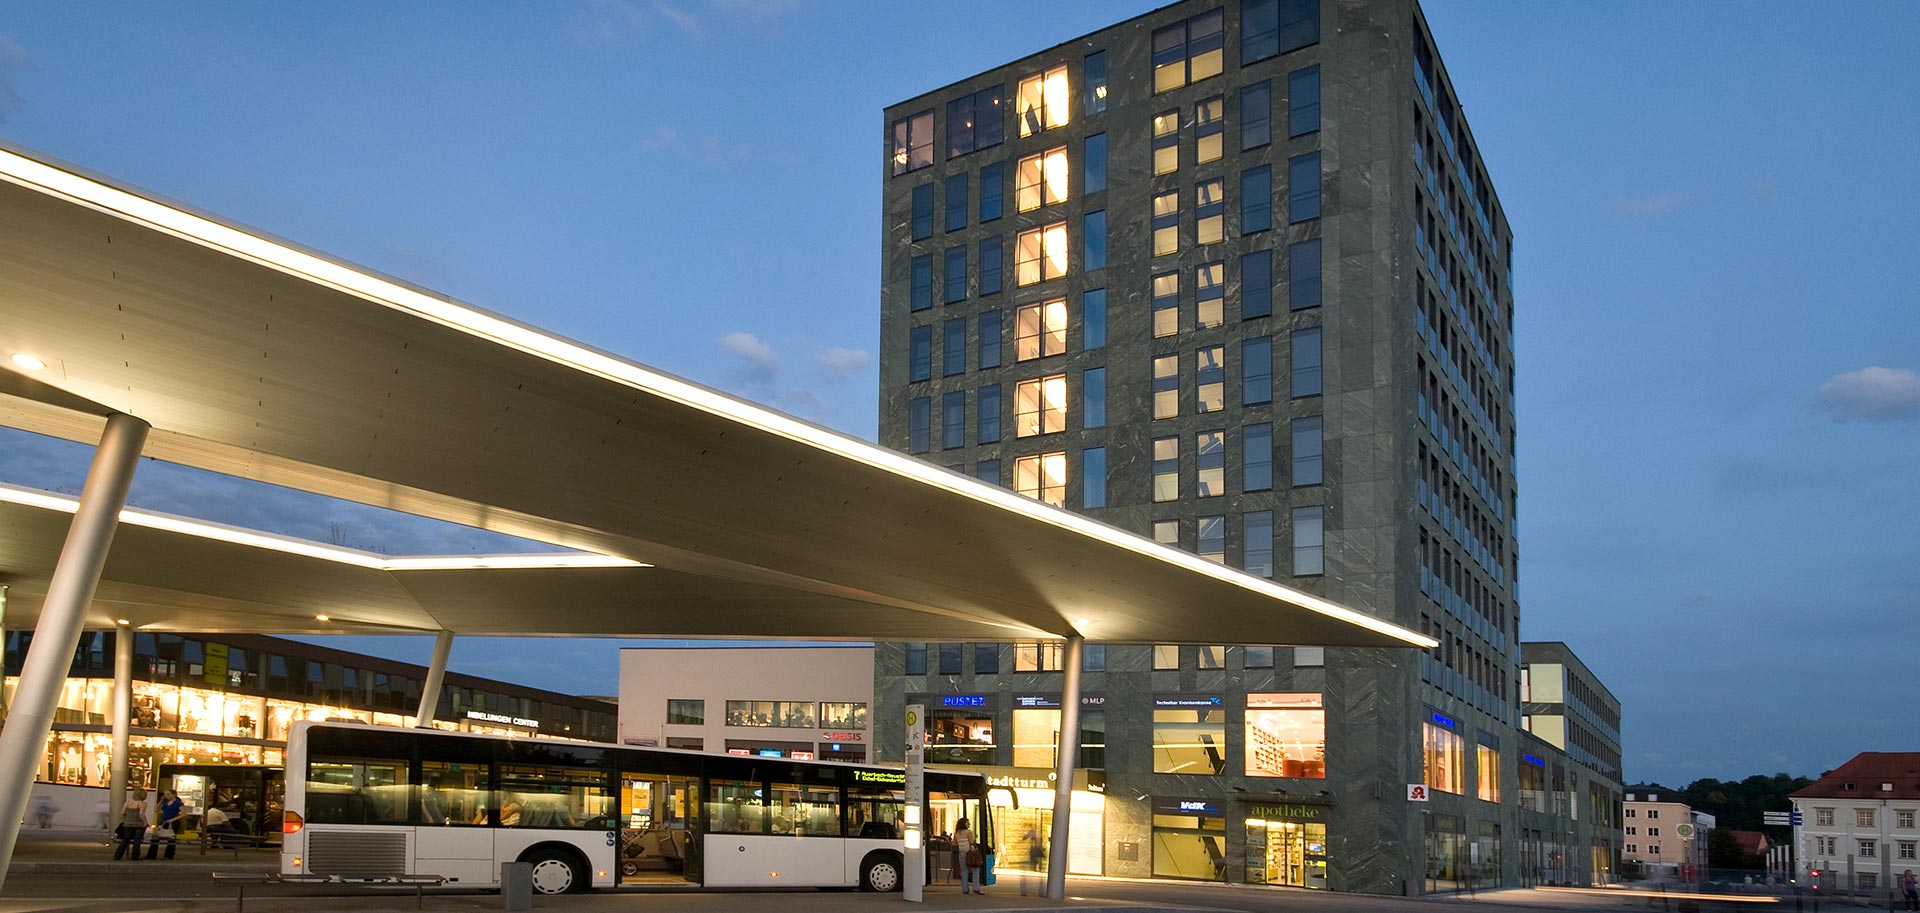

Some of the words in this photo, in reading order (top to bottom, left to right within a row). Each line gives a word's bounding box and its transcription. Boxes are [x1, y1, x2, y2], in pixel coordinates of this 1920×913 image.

[1089, 697, 1105, 705] MLP
[467, 710, 512, 724] NIBELUNGEN
[512, 717, 539, 728] CENTER
[853, 770, 860, 780] 7
[987, 775, 1049, 788] tadtturm
[1180, 801, 1206, 811] VdK
[1251, 804, 1319, 818] apotheke
